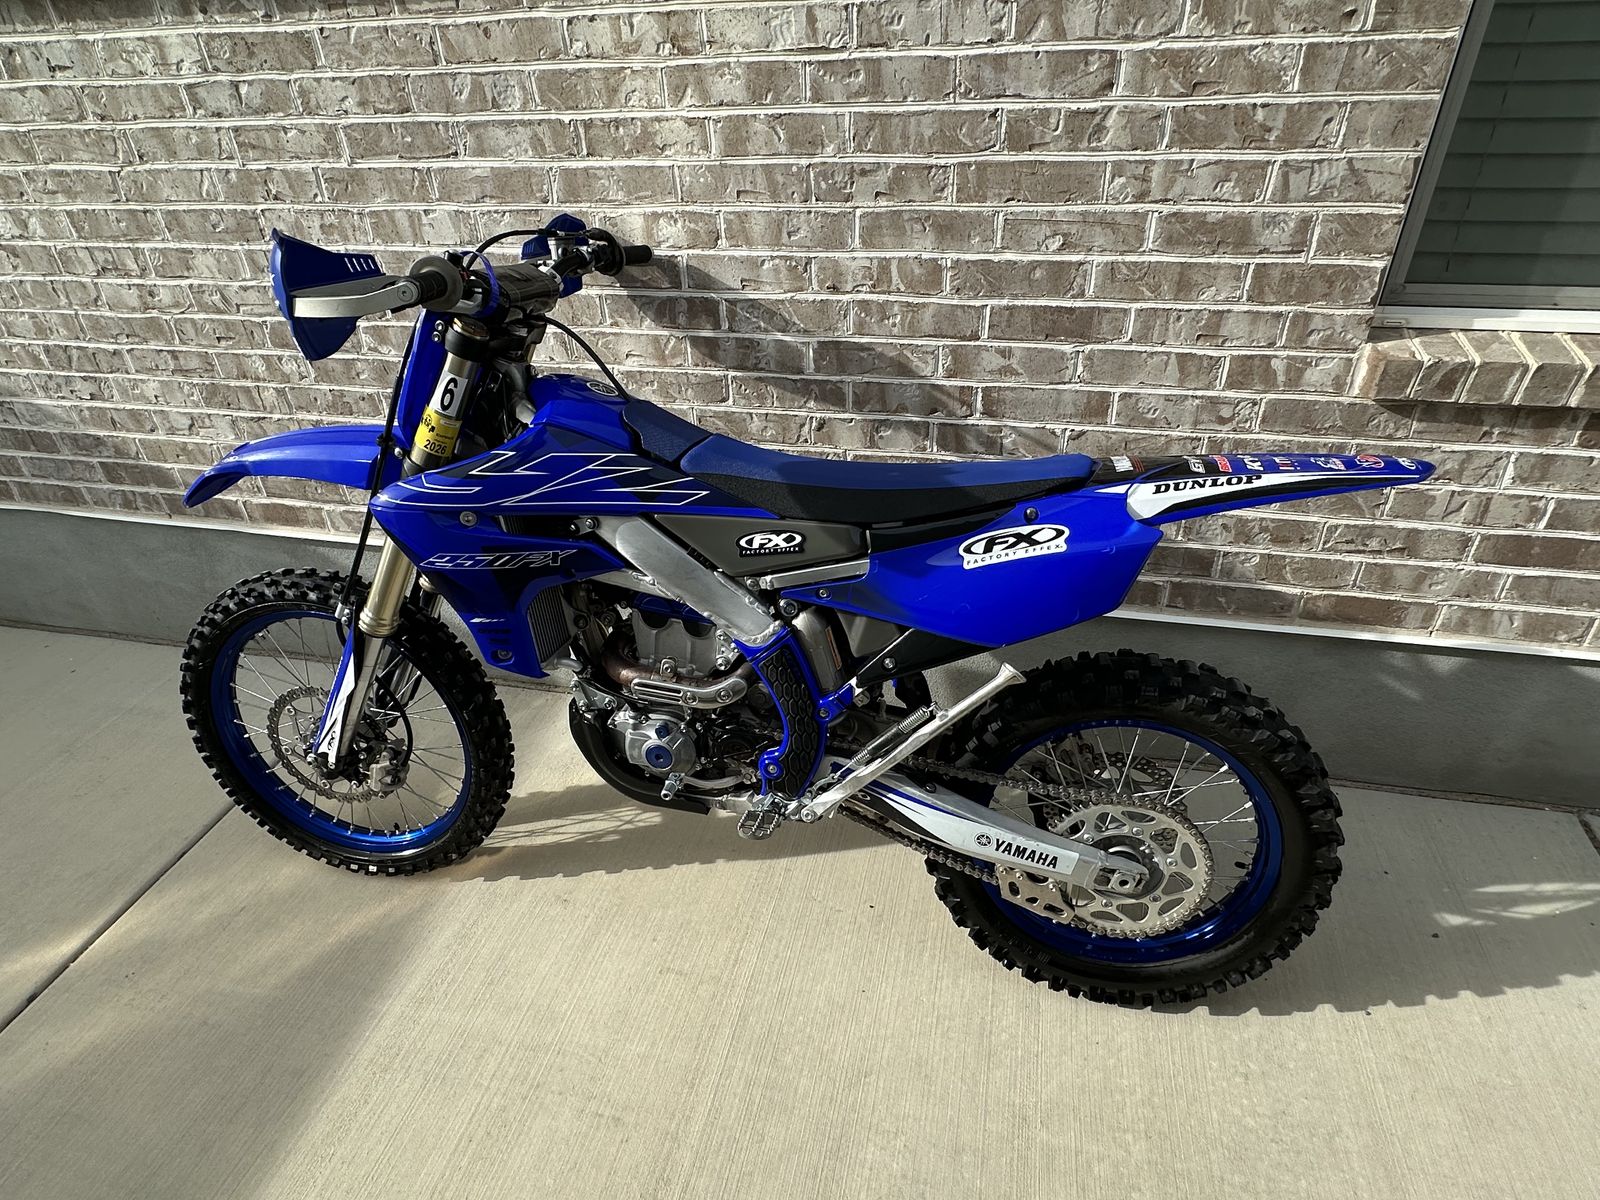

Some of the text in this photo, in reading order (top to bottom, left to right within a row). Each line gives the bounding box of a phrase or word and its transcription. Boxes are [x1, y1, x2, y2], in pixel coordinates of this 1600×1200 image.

[439, 377, 459, 412] 6
[423, 439, 448, 455] 2026
[1152, 474, 1263, 495] DUNLOP
[970, 527, 1058, 555] FX
[419, 549, 578, 570] 250FX
[966, 550, 1017, 566] FACTORY
[993, 838, 1059, 869] YAMAHA
